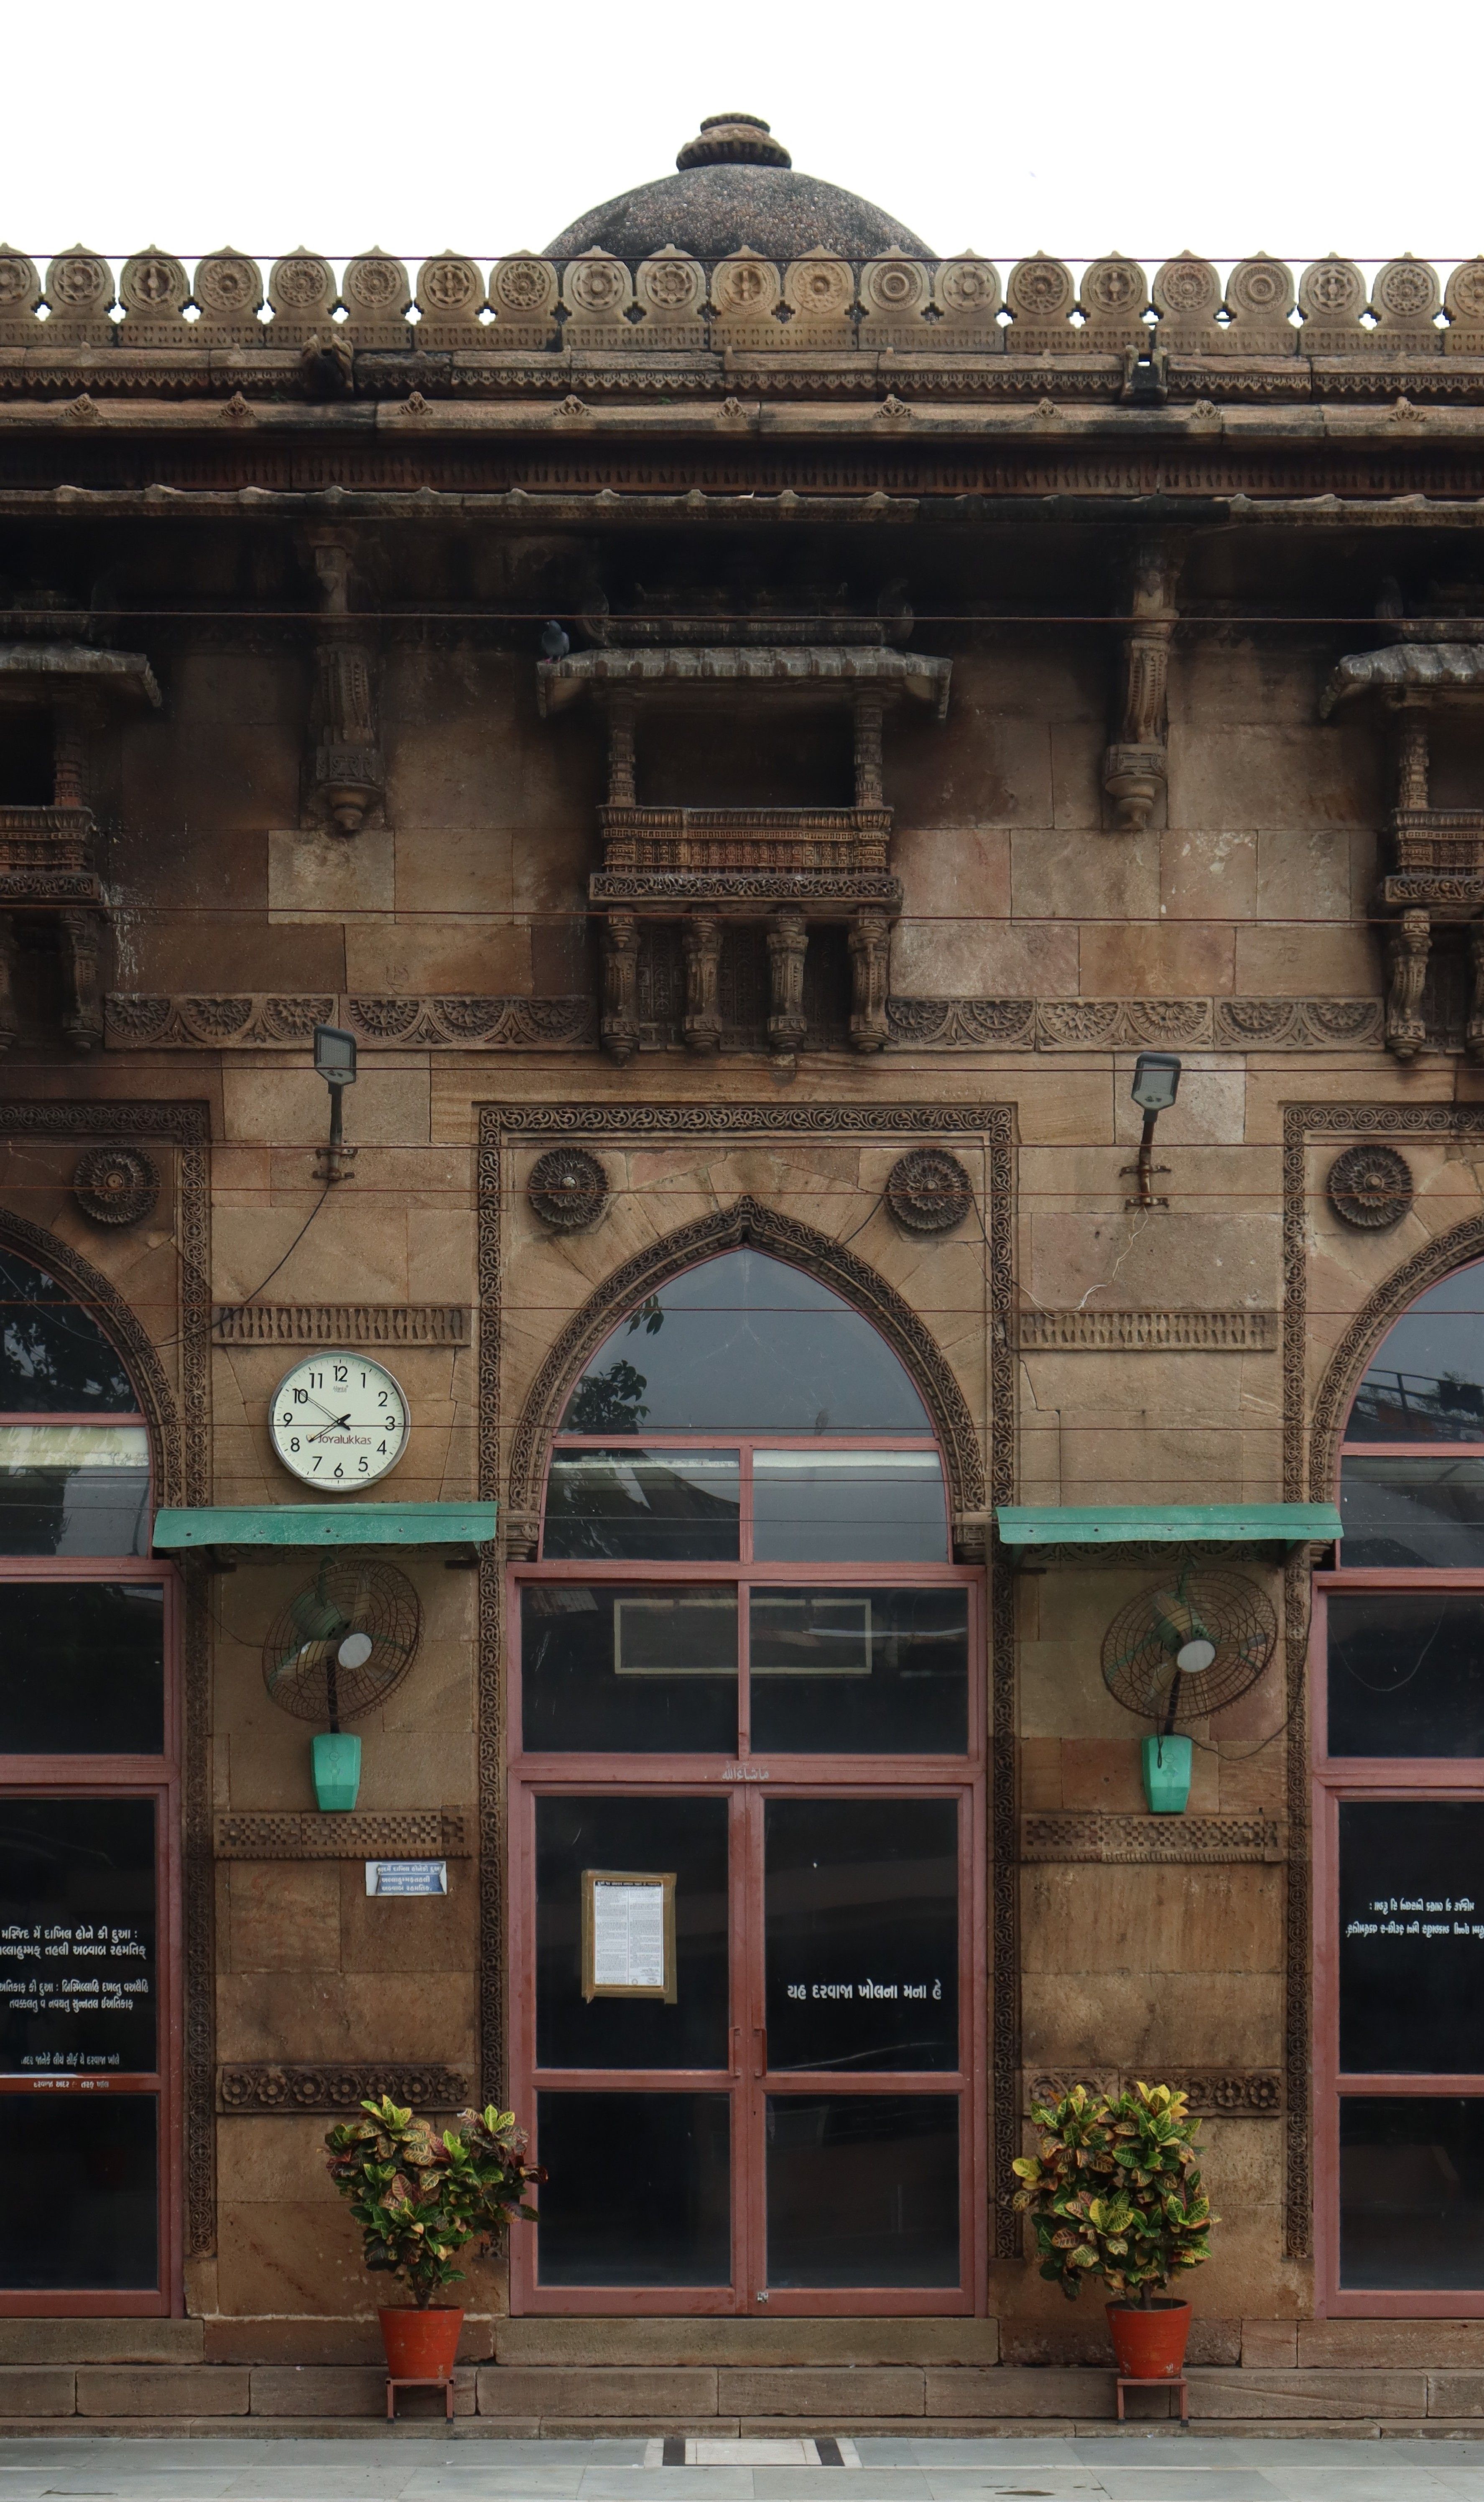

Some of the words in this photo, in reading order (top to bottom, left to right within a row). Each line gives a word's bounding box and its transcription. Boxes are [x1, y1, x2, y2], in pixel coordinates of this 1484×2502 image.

[309, 1373, 323, 1389] 11
[333, 1366, 348, 1382] 12
[361, 1373, 366, 1388] 1
[293, 1388, 308, 1404] 10
[378, 1391, 388, 1407] 2
[283, 1413, 293, 1427] 9
[385, 1416, 395, 1430] 3
[291, 1437, 300, 1452] 8
[318, 1434, 372, 1445] Joyalukkas
[377, 1440, 387, 1455] 4
[312, 1456, 322, 1471] 7
[334, 1463, 344, 1477] 6
[358, 1457, 368, 1472] 5
[44, 1925, 72, 1939] દાખિલ
[75, 1925, 93, 1940] હોને
[97, 1925, 108, 1939] કી
[111, 1929, 131, 1943] દુઆ
[45, 1942, 69, 1956] તહલી
[73, 1945, 106, 1956] અબ્વાબ
[29, 1979, 36, 1992] કી
[39, 1983, 54, 1996] દુઆ
[787, 1984, 806, 2000] યહ
[812, 1984, 853, 1999] દરવાજા
[858, 1979, 898, 1999] ખોલના
[903, 1985, 926, 1999] મના
[932, 1979, 941, 2000] હે
[41, 1999, 46, 2008] વ
